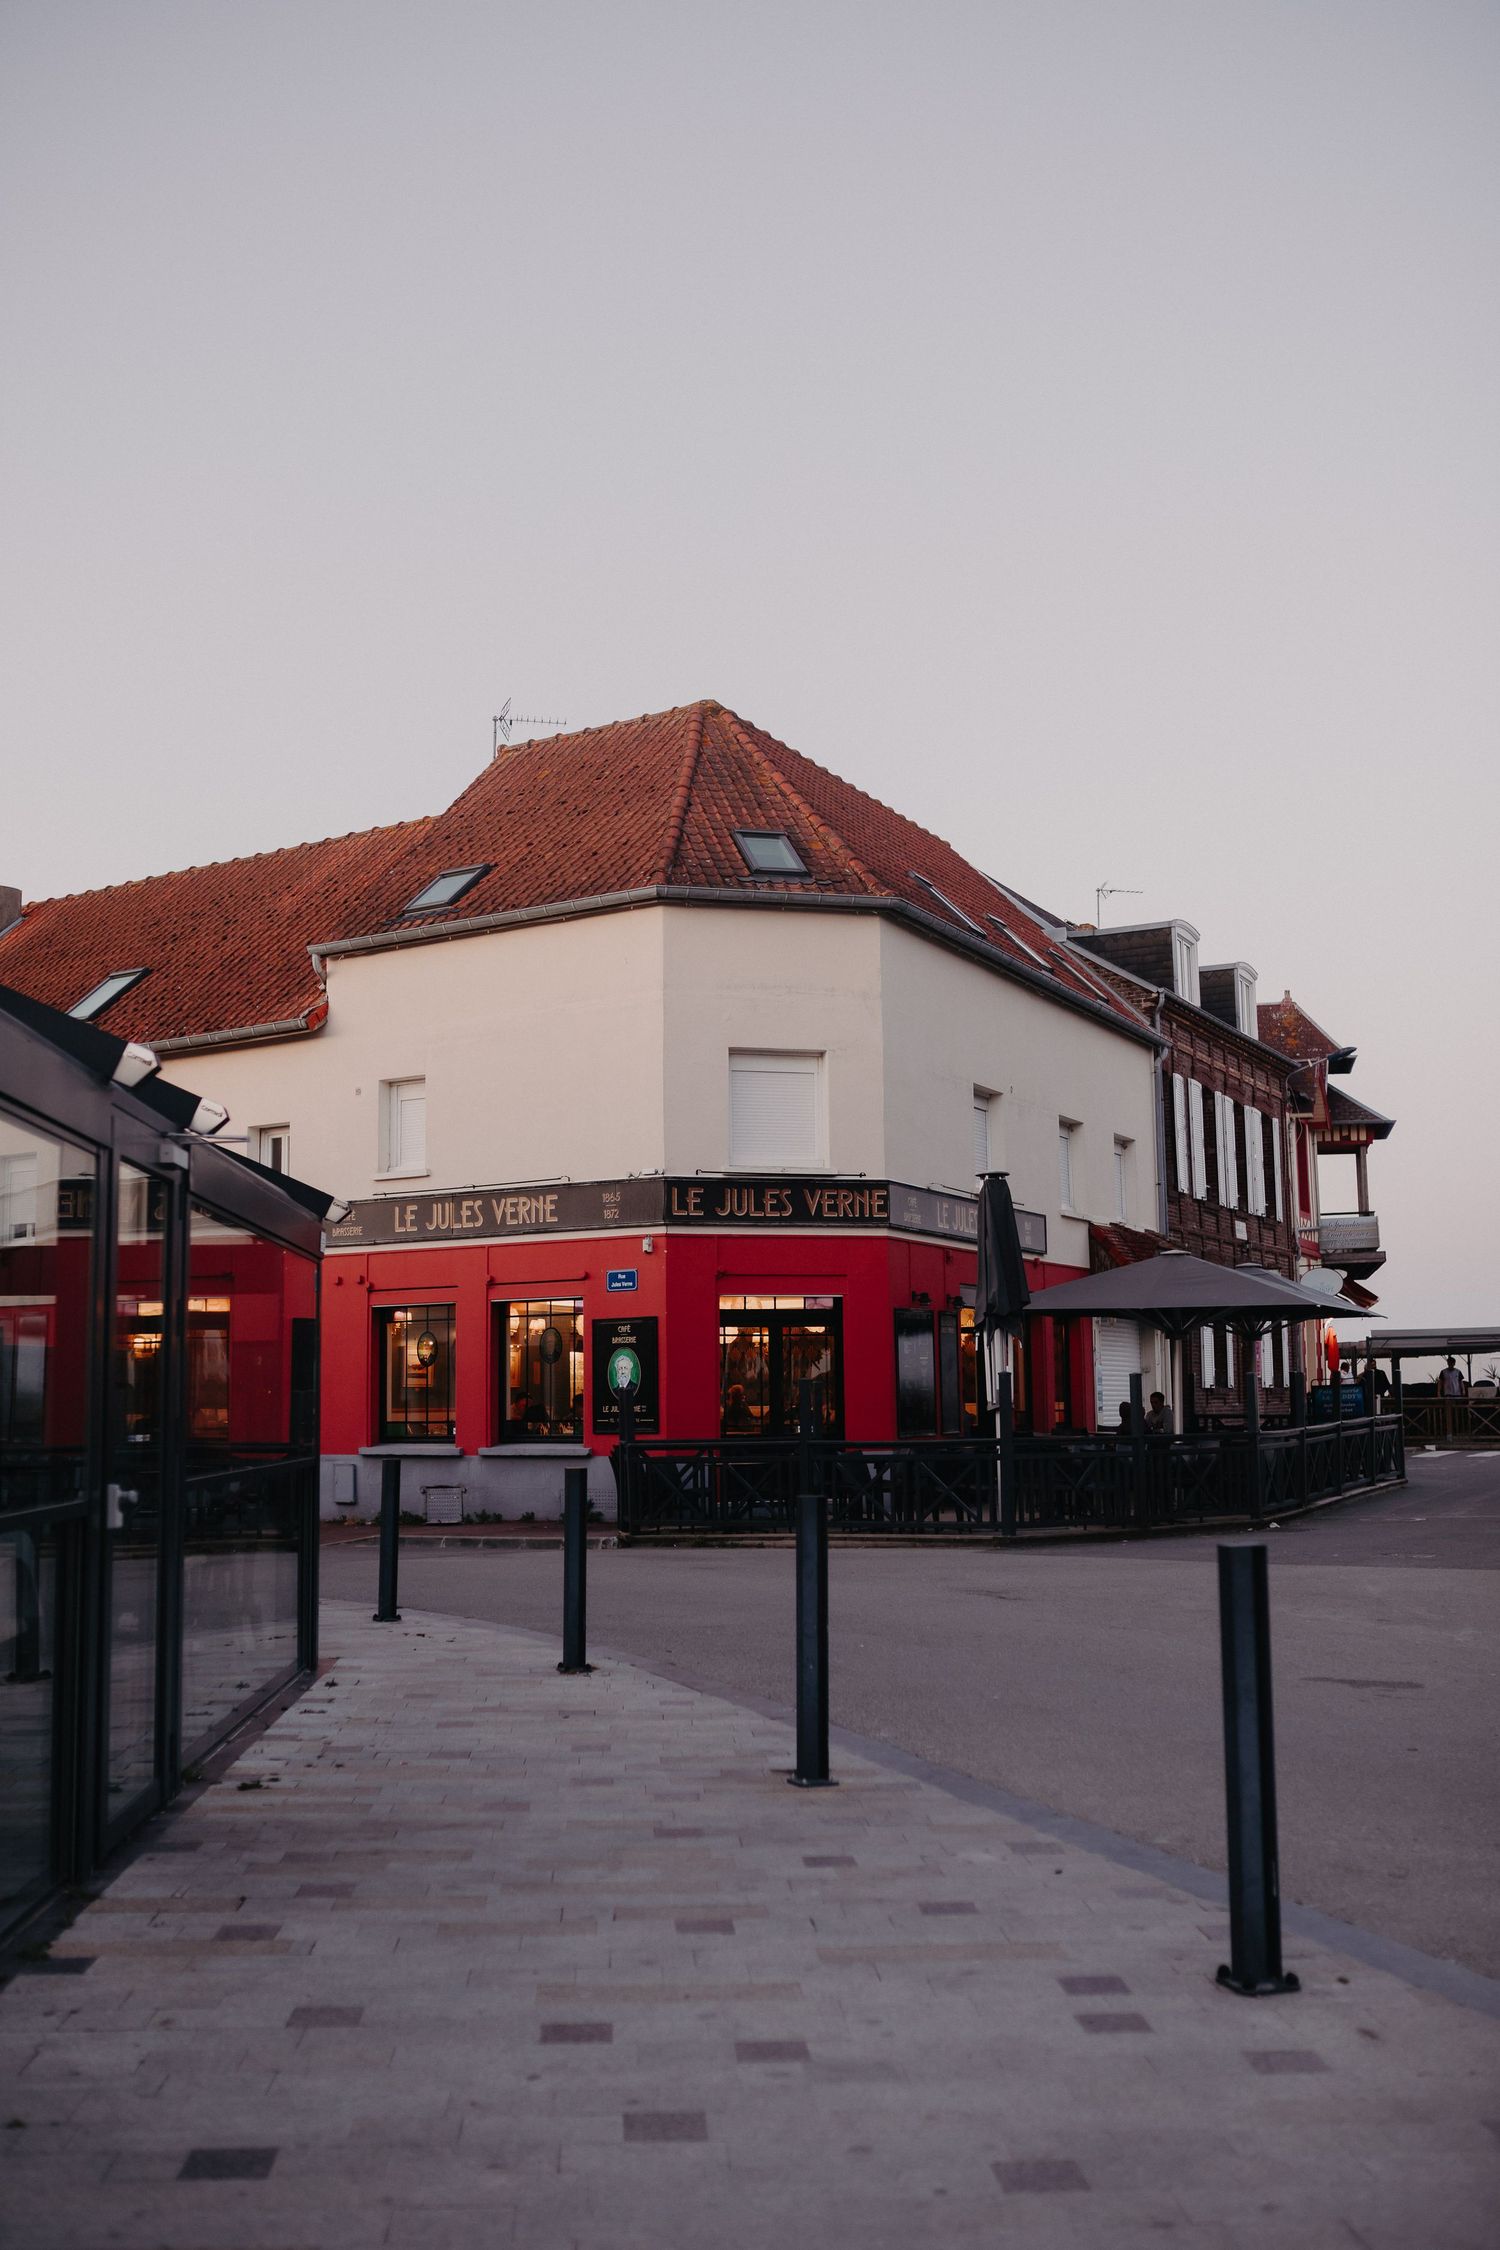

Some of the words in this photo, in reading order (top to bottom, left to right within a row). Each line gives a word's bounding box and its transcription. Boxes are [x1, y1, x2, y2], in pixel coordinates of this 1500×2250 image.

[671, 1187, 704, 1217] LE
[715, 1188, 792, 1218] JULES
[803, 1188, 888, 1218] VERNE
[394, 1204, 418, 1233] LE
[425, 1200, 484, 1230] JULES
[492, 1194, 559, 1226] VERNE
[603, 1208, 620, 1219] 1872
[937, 1200, 950, 1229] LE
[332, 1226, 364, 1238] BRASSERIE
[602, 1405, 609, 1413] LE
